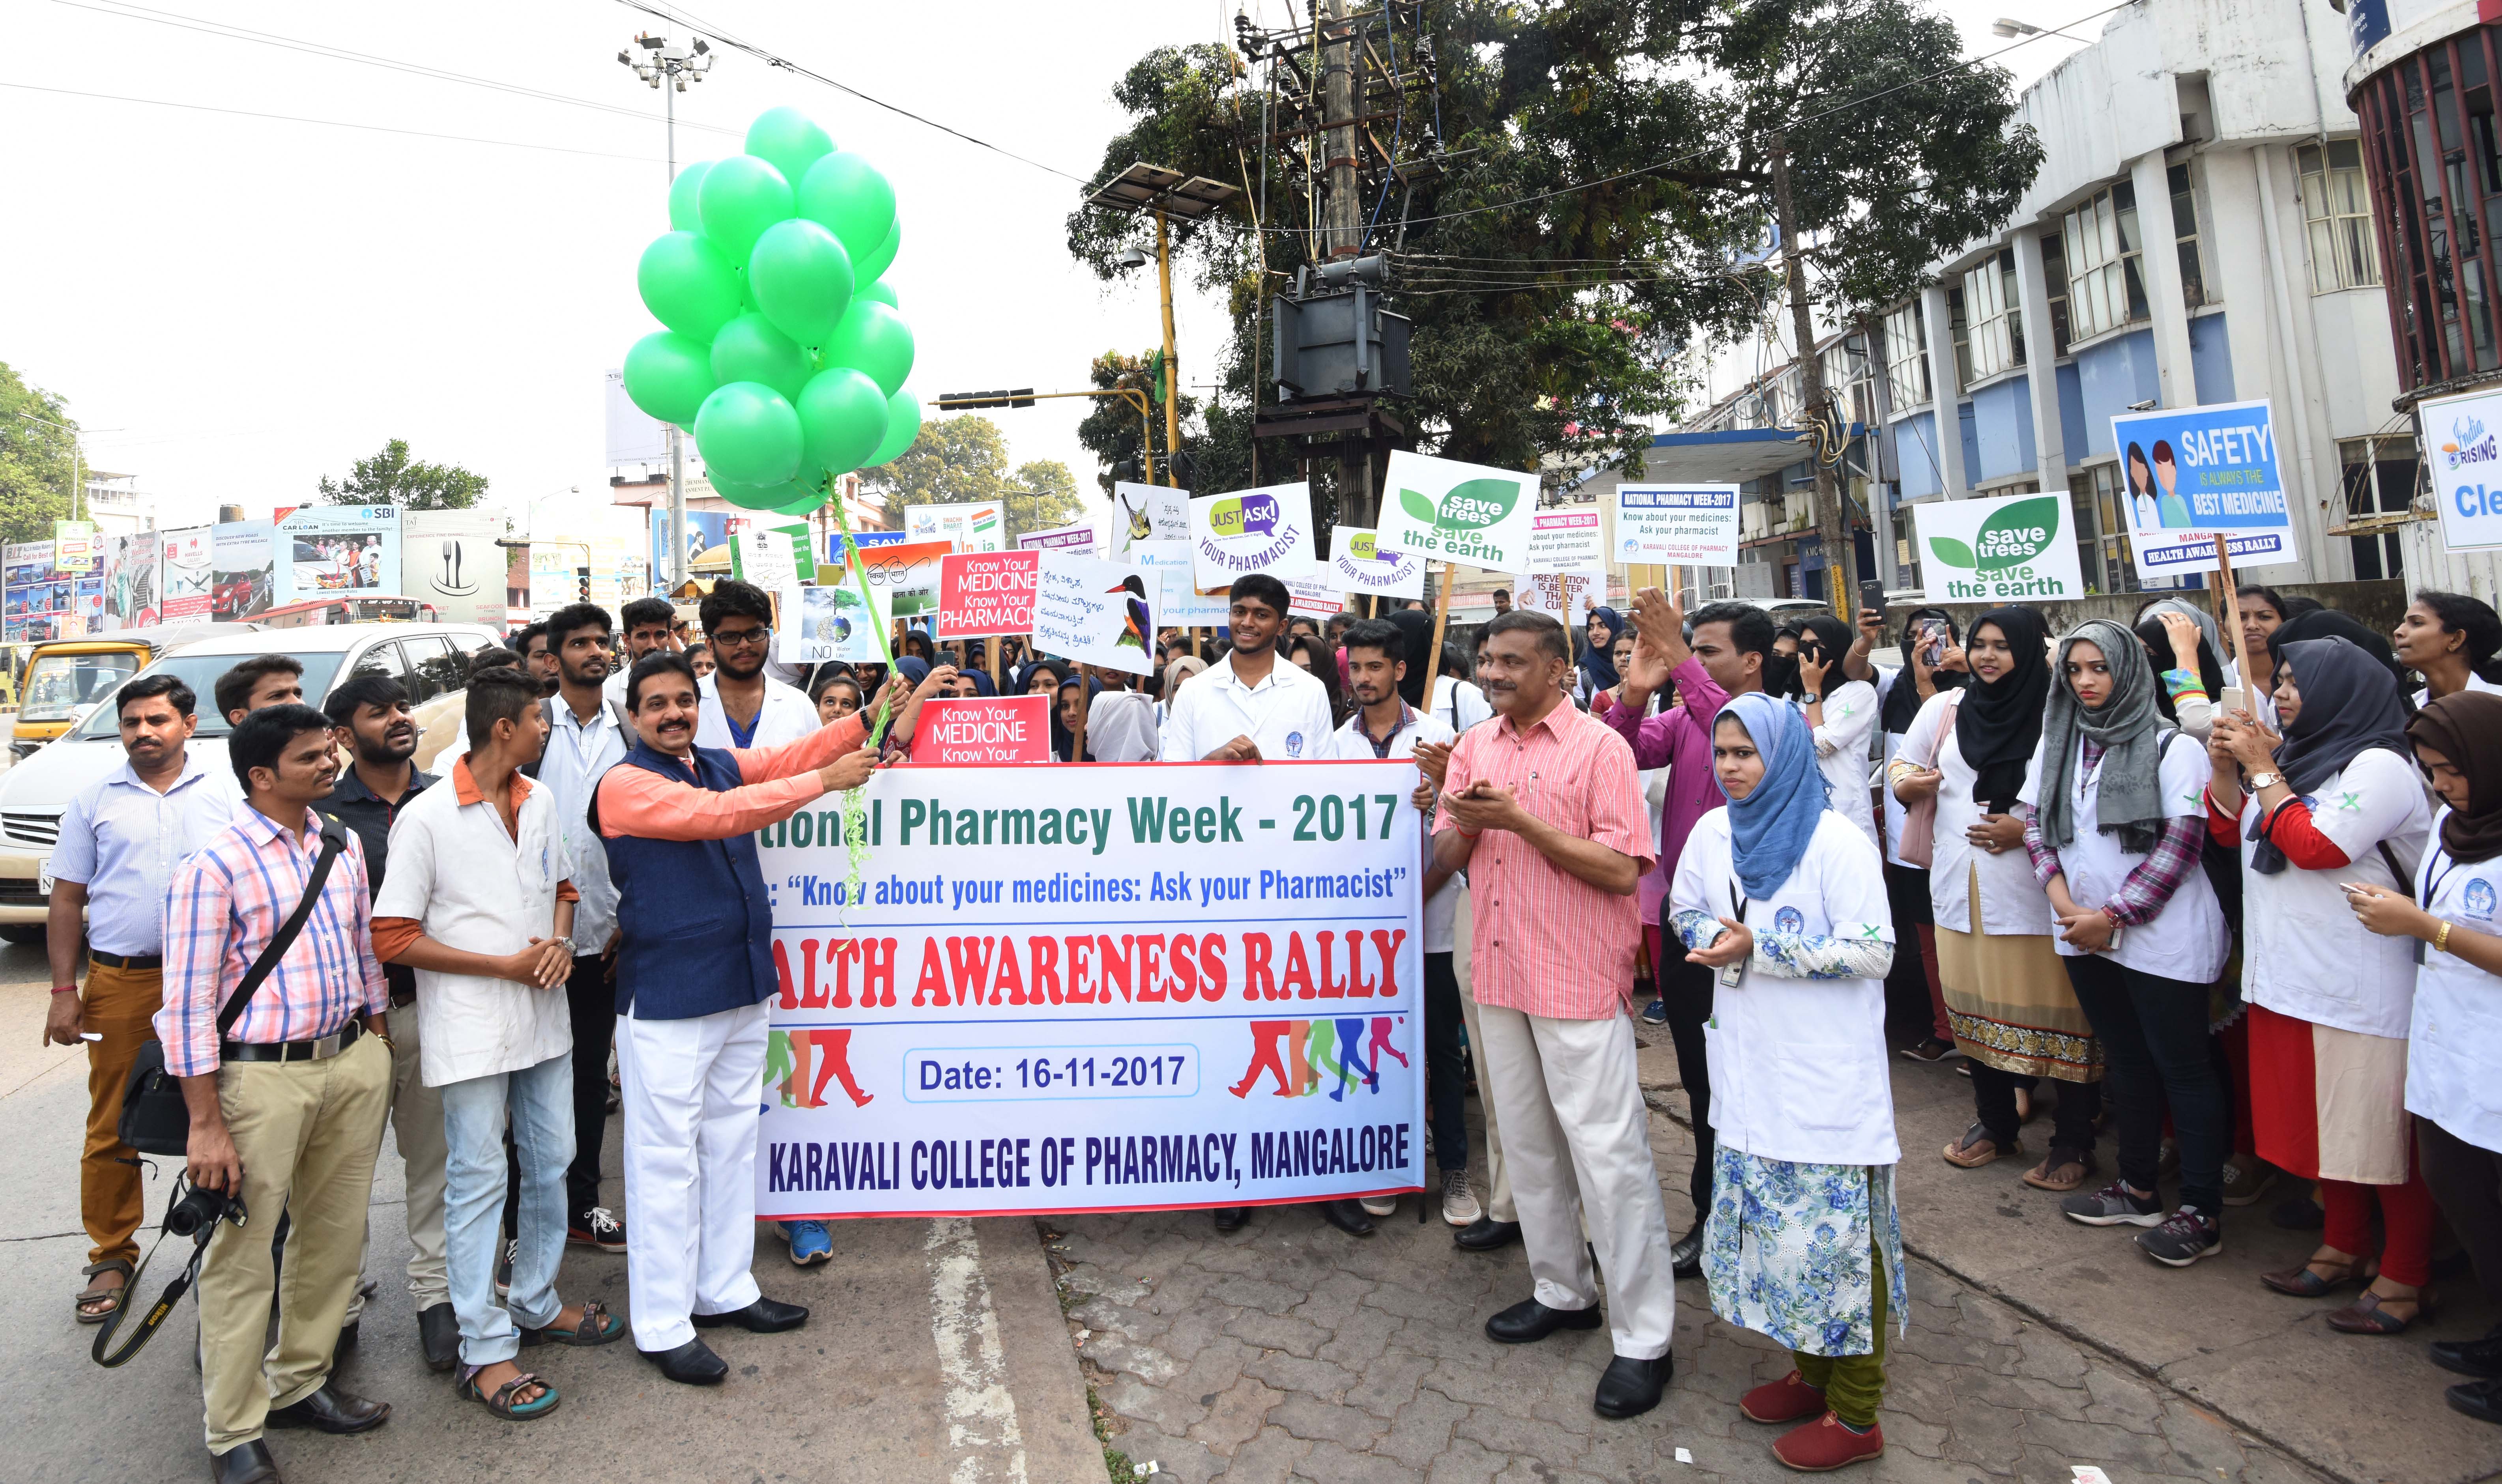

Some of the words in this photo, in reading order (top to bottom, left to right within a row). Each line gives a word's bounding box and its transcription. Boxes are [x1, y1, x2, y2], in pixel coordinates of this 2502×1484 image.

[2181, 424, 2269, 467] SAFETY
[2460, 434, 2497, 464] RISING
[2200, 471, 2208, 486] IS
[2209, 469, 2244, 485] ALWAYS
[2244, 469, 2264, 484] THE
[1449, 496, 1503, 516] save
[1625, 494, 1655, 505] NATIONAL
[1657, 494, 1692, 505] PHARMACY
[1693, 494, 1731, 506] WEEK-2017
[2193, 492, 2220, 516] BEST
[2222, 490, 2285, 515] MEDICINE
[374, 508, 394, 518] SBI
[1212, 510, 1241, 527] JUST
[1244, 500, 1276, 523] ASK!
[1442, 504, 1491, 525] trees
[1623, 512, 1643, 521] Know
[1646, 513, 1667, 521] about
[1670, 514, 1686, 523] your
[1689, 513, 1731, 522] medicines:
[920, 523, 936, 534] RISING
[1539, 518, 1567, 527] PHARMACY
[1568, 516, 1596, 526] WEEK-2017
[1431, 525, 1483, 544] save
[1640, 525, 1653, 534] Ask
[1656, 527, 1672, 536] your
[1675, 526, 1718, 536] pharmacist
[1985, 527, 2046, 545] save
[132, 537, 154, 546] Exclusive
[1023, 539, 1043, 549] NATIONAL
[1043, 535, 1066, 547] PHARMACY
[1066, 532, 1091, 544] WEEK-2017
[1200, 536, 1225, 566] YOUR
[1229, 524, 1300, 571] PHARMACIST
[1351, 541, 1374, 552] JUST
[1404, 530, 1437, 549] the
[1445, 541, 1503, 562] earth
[1557, 541, 1590, 550] pharmacist
[131, 548, 152, 556] Wedding
[1806, 546, 1818, 557] KMC
[1978, 541, 2036, 557] trees
[2147, 549, 2185, 563] HEALTH
[2186, 542, 2244, 559] AWAREESS
[2244, 537, 2277, 551] RALLY
[967, 559, 1001, 573] Know
[1003, 558, 1031, 571] Your
[1141, 555, 1187, 565] Medication
[870, 572, 884, 581] स्वच्छ
[1337, 554, 1358, 578] YOUR
[1358, 561, 1416, 586] PHARMACIST
[1975, 566, 2034, 582] save
[958, 570, 1038, 592] MEDICINE
[1538, 582, 1546, 591] IS
[1549, 583, 1583, 593] BETER
[1947, 580, 1986, 598] the
[1995, 577, 2064, 596] earth
[965, 594, 1000, 608] Know
[1002, 592, 1030, 606] Your
[1295, 589, 1321, 598] MANGALORE
[1188, 607, 1230, 615] pharmac
[1295, 598, 1323, 610] AWARENESS
[1323, 602, 1340, 612] RALLY
[1545, 600, 1572, 611] CUE
[941, 607, 1035, 629] PHARMACIS
[812, 646, 831, 659] NO
[942, 708, 981, 722] Know
[985, 706, 1018, 721] Your
[933, 721, 1027, 744] MEDICINE
[942, 748, 982, 762] Know
[986, 747, 1019, 761] Your
[760, 799, 882, 848] tional
[900, 798, 1112, 856] Pharmacy
[1127, 796, 1244, 844] Week
[1259, 819, 1275, 829] -
[1293, 794, 1398, 842] 2017
[788, 875, 867, 906] “Know
[875, 874, 944, 905] about
[952, 880, 1004, 911] your
[1013, 872, 1141, 903] medicines:
[1150, 871, 1192, 902] Ask
[1201, 875, 1251, 908] your
[1260, 867, 1407, 900] Pharmacist”
[771, 937, 898, 1010] ALTH
[911, 932, 1227, 1007] AWARENESS
[1242, 928, 1407, 1002] RALLY
[920, 1060, 1001, 1090] Date:
[1016, 1056, 1185, 1088] 16-11-2017
[769, 1141, 900, 1193] KARAVALI
[911, 1137, 1030, 1191] COLLEGE
[1041, 1136, 1075, 1187] OF
[1086, 1133, 1241, 1190] PHARMACY,
[1251, 1123, 1409, 1180] MANGALORE
[148, 1303, 168, 1326] Nikon
